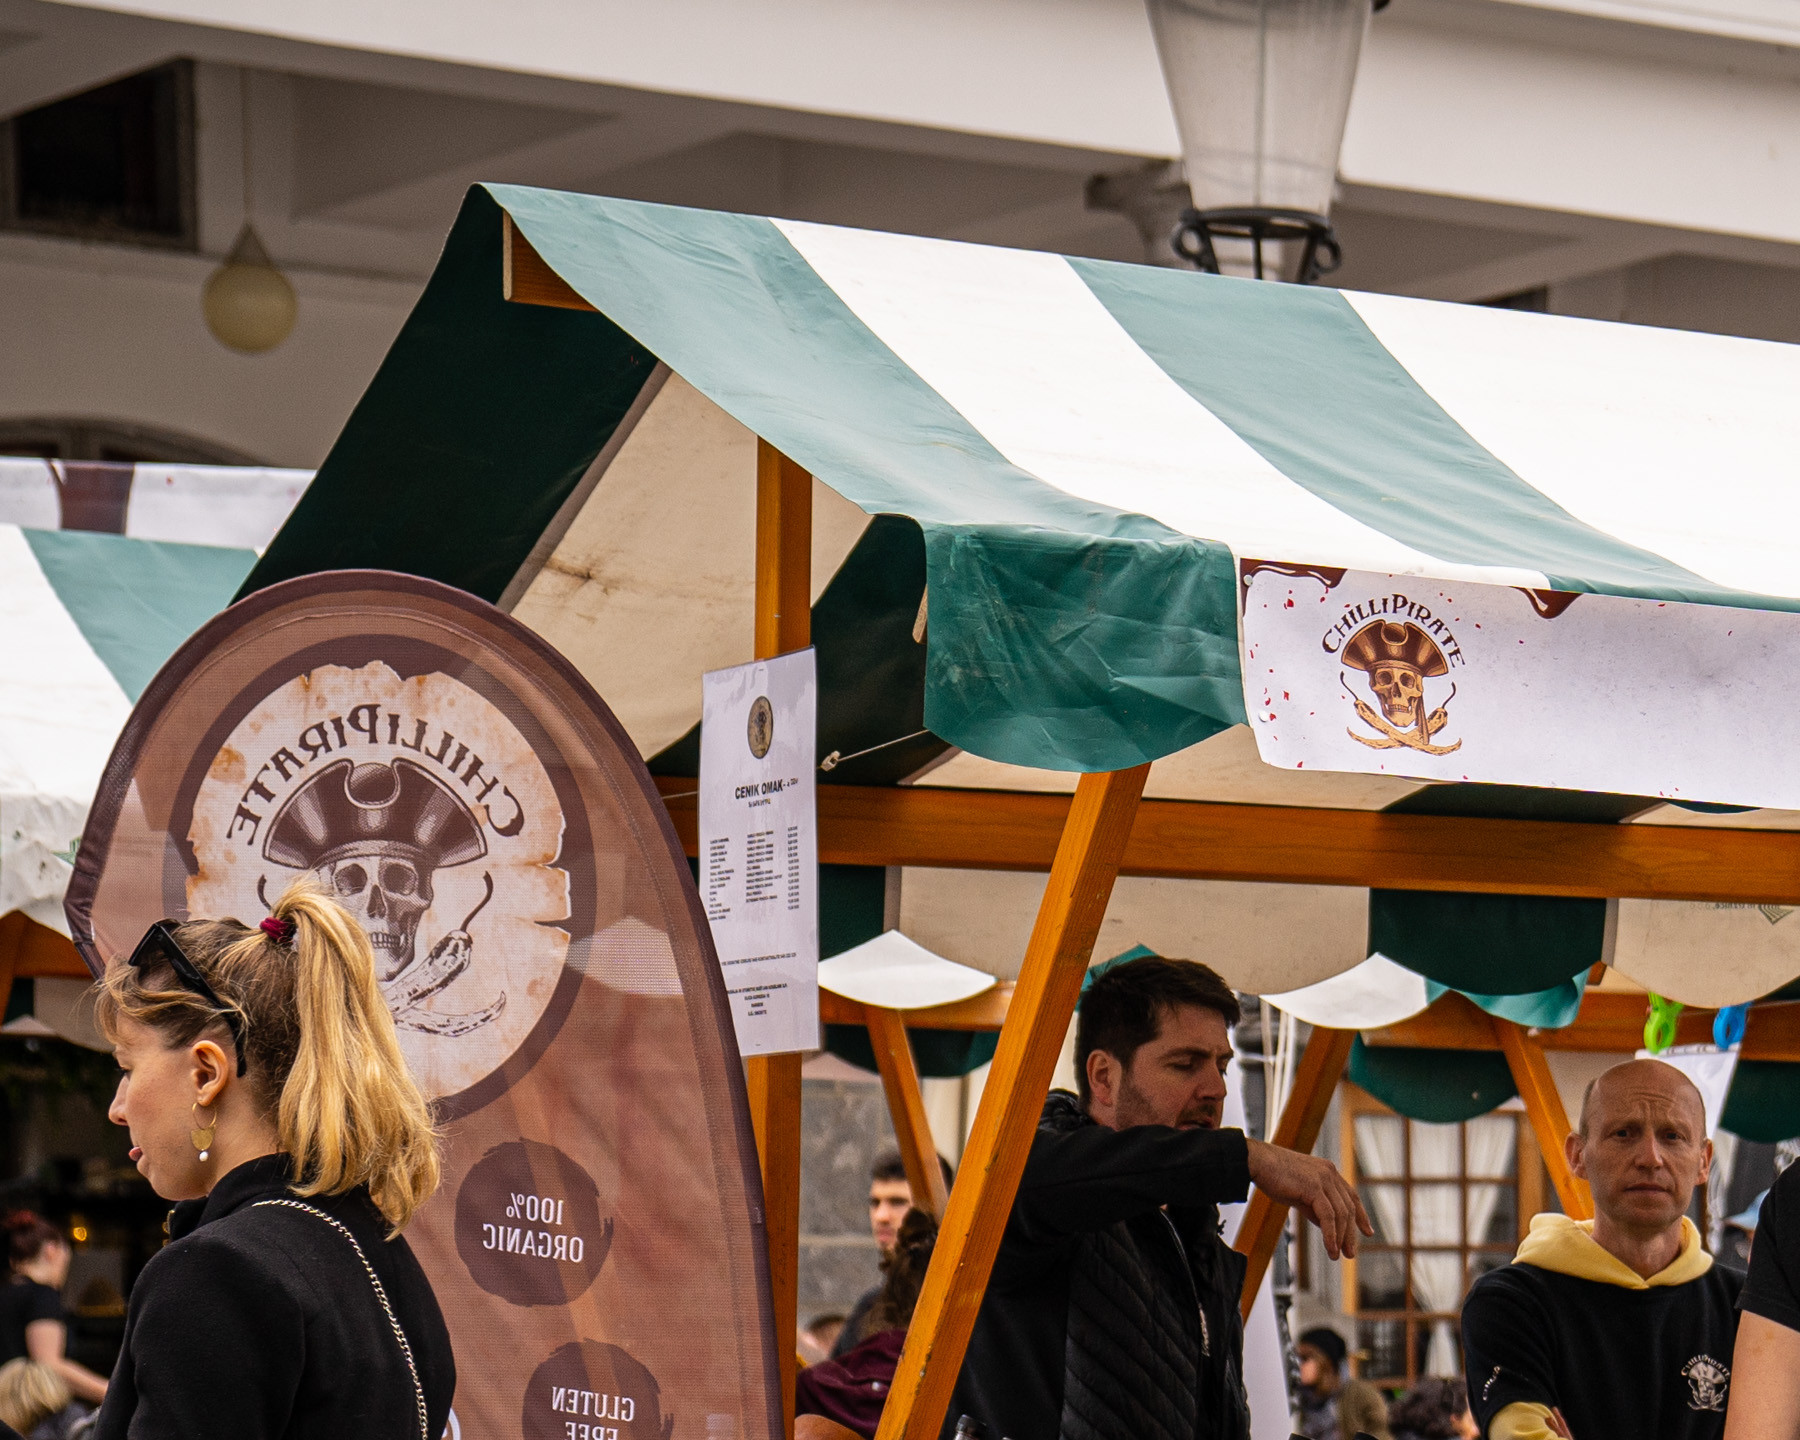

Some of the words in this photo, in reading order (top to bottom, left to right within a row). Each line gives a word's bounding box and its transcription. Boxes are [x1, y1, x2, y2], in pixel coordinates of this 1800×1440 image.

[1322, 593, 1466, 668] CHILLIPIRATE
[735, 784, 760, 799] CENIK
[761, 779, 783, 794] OMAK
